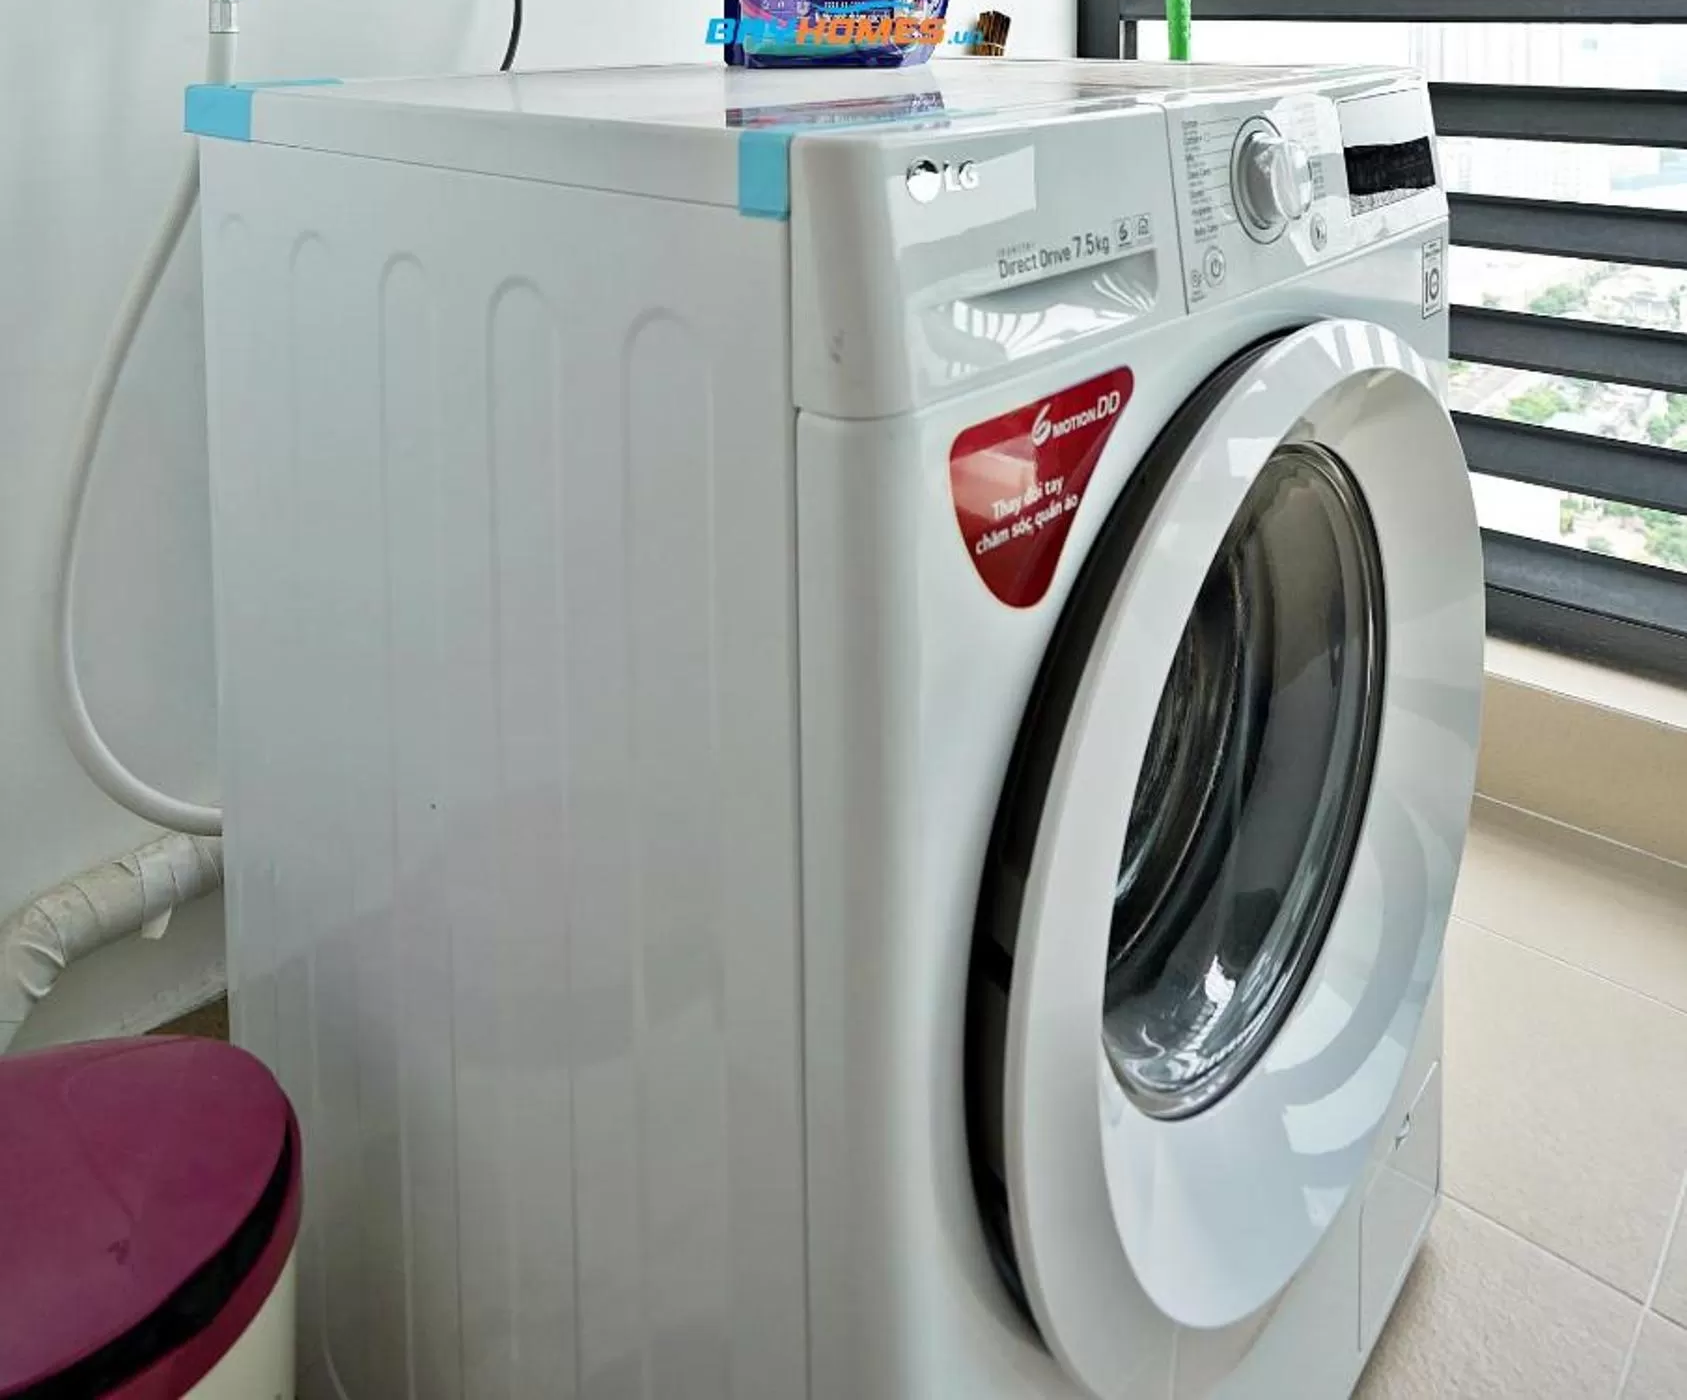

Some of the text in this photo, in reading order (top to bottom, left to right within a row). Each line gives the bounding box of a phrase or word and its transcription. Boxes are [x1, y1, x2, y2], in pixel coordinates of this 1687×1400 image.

[943, 160, 979, 192] LG
[999, 254, 1038, 279] Direct
[1039, 245, 1072, 267] Drive
[1072, 231, 1111, 260] 7.5kg
[992, 495, 1022, 520] Thay
[1045, 477, 1065, 497] tay
[1063, 493, 1079, 511] áo
